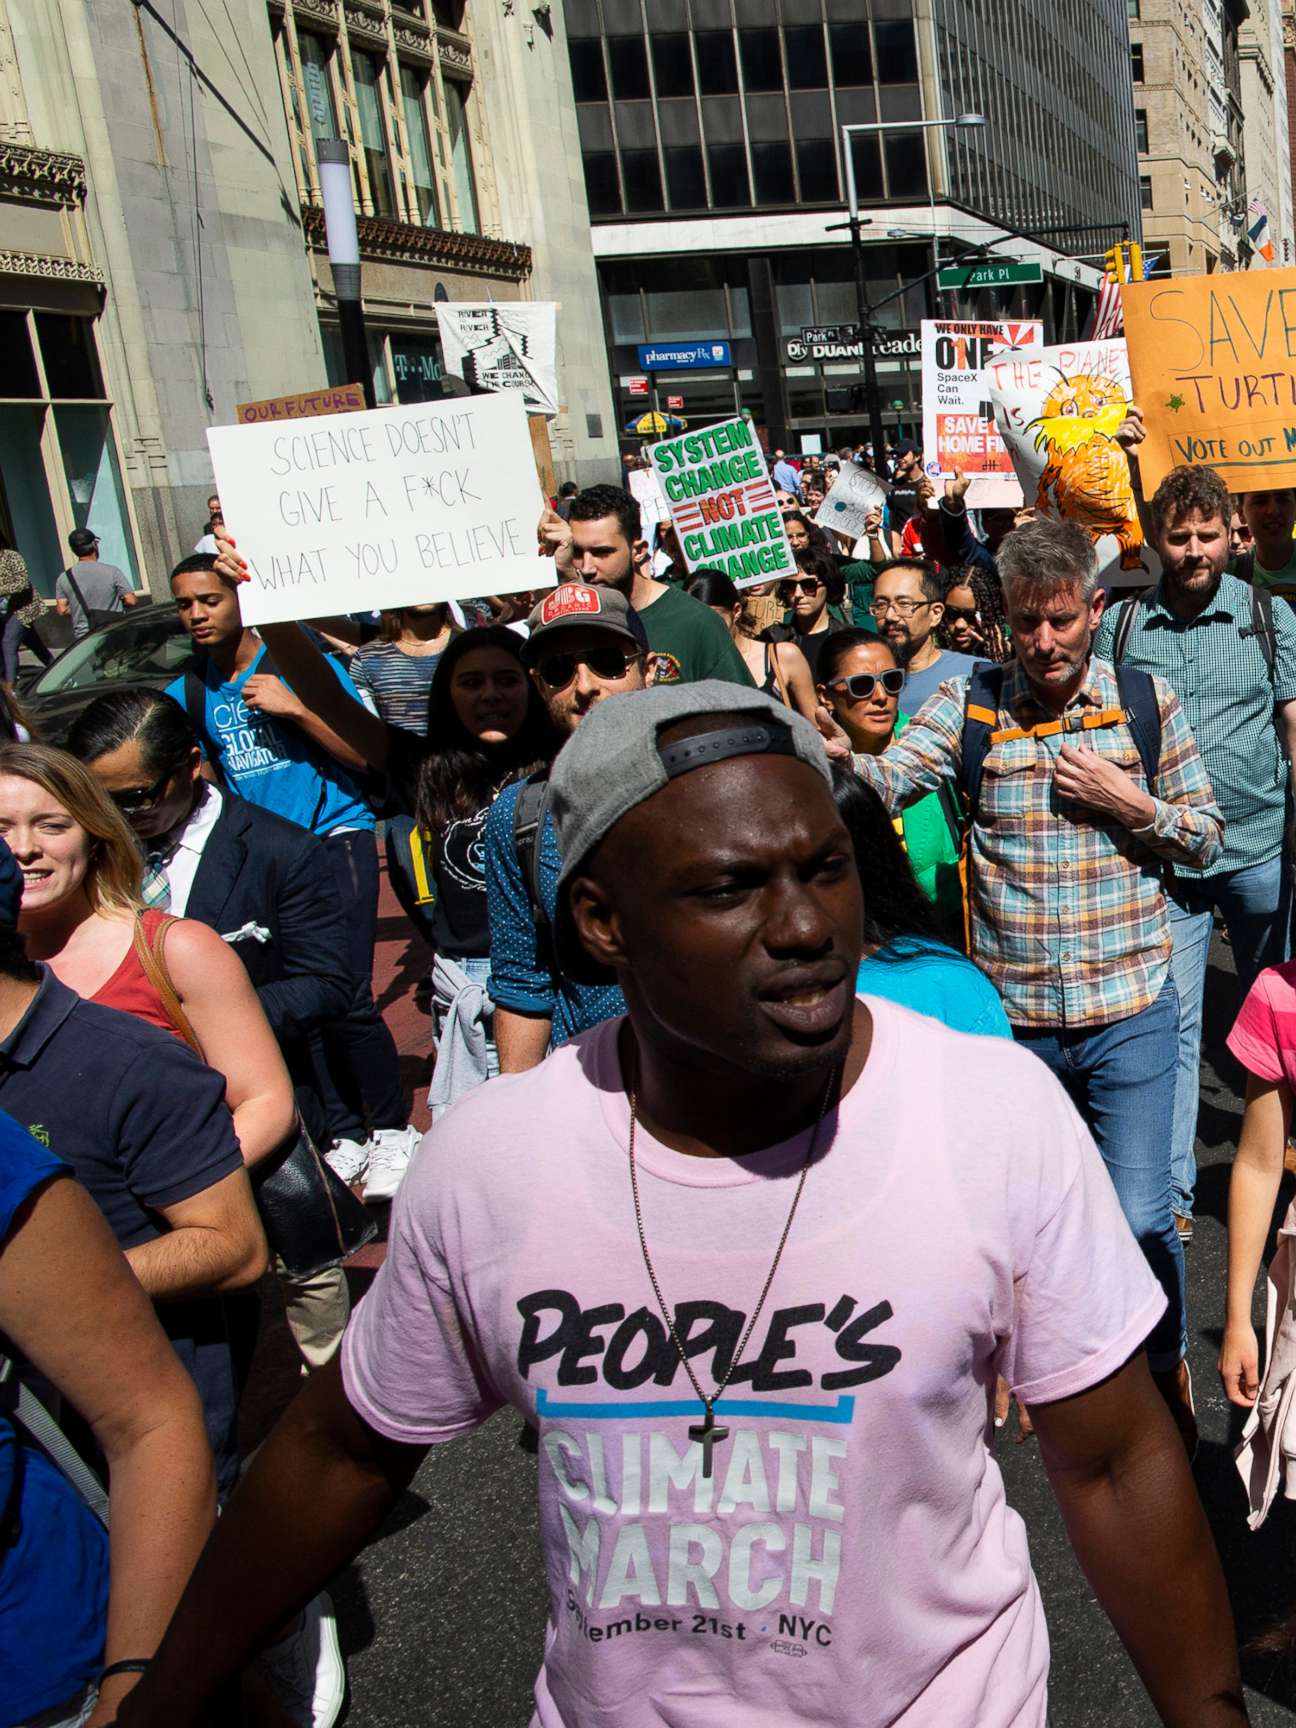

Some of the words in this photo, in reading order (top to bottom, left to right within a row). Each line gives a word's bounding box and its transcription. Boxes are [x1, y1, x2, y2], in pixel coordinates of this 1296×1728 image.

[998, 267, 1010, 280] Pl
[935, 323, 952, 334] WE
[954, 324, 977, 335] ONLY
[979, 325, 1004, 336] HAVE
[645, 349, 698, 365] pharmacy
[937, 372, 978, 383] SpaceX
[937, 384, 959, 394] Can
[992, 360, 1042, 391] THE
[244, 403, 281, 423] OUR
[285, 393, 361, 416] FUTURE
[937, 395, 965, 406] Wait.
[944, 416, 989, 434] SAVE
[1003, 407, 1025, 431] IS
[271, 427, 376, 475] SCIENCE
[385, 412, 477, 457] DOESN'T
[653, 421, 753, 473] SYSTEM
[938, 435, 985, 454] HOME
[1175, 438, 1228, 463] VOTE
[1238, 436, 1277, 458] OUT
[664, 450, 764, 502] CHANGE
[279, 485, 343, 526] GIVE
[365, 480, 389, 518] A
[698, 488, 746, 526] NOT
[683, 511, 784, 563] CLIMATE
[250, 547, 328, 591] WHAT
[345, 538, 399, 580] YOU
[415, 518, 528, 568] BELIEVE
[517, 1290, 902, 1391] PEOPLE'S
[543, 1430, 848, 1522] CLIMATE
[559, 1501, 842, 1616] MARCH
[692, 1614, 746, 1641] 21st
[778, 1613, 833, 1647] NYC
